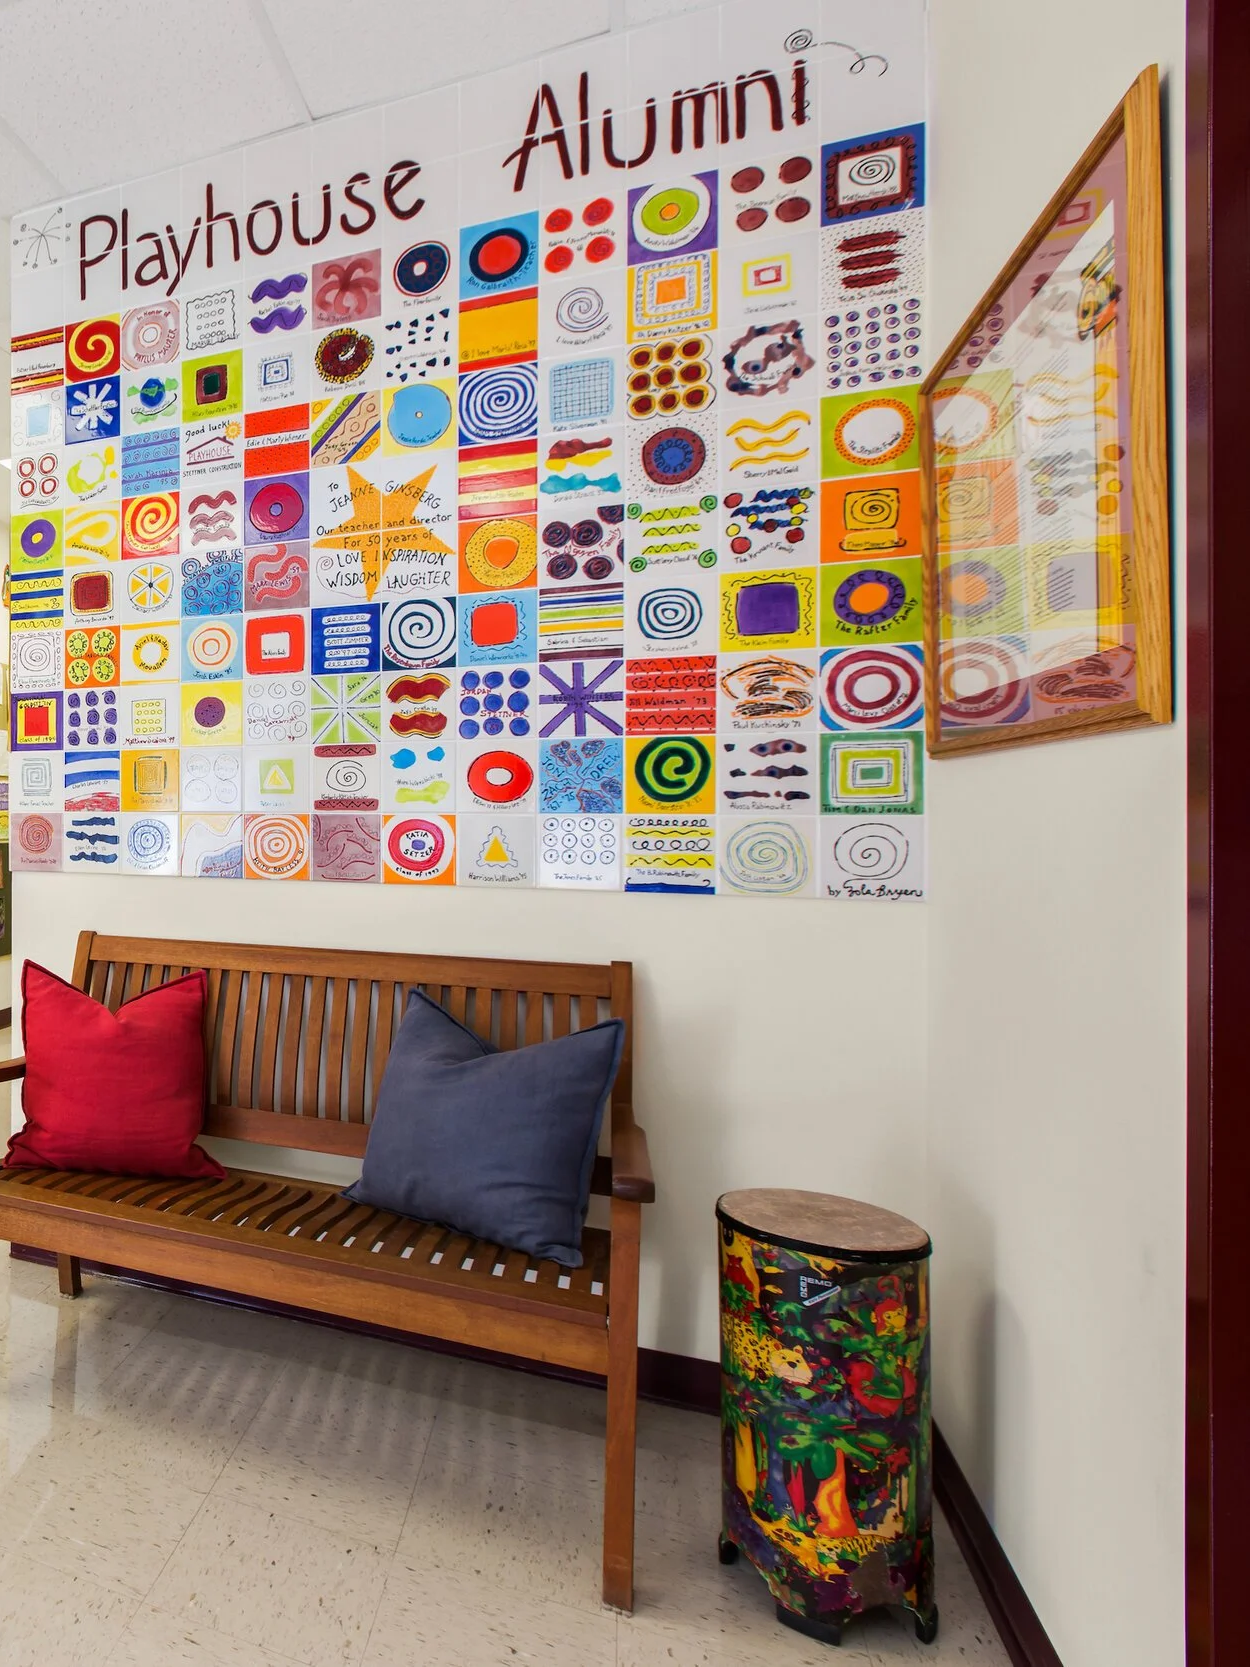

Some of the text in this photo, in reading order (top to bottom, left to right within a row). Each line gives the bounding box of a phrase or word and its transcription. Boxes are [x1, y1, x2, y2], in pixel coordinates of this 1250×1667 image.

[79, 50, 810, 301] Playhouse Alumni
[133, 351, 157, 365] PHYLLIS
[157, 327, 179, 361] MAURER
[188, 445, 232, 462] PLAYHOUSE
[329, 480, 442, 513] JEANNE GINSBERG
[316, 512, 452, 537] Our teacher and director
[343, 528, 434, 550] For 50 years of
[336, 549, 447, 568] LOVE INSPIRATION
[250, 575, 292, 595] MARK LEWIS
[326, 570, 452, 590] WISDOM LAUGHTER
[835, 619, 852, 635] The
[892, 597, 919, 626] Family
[460, 688, 492, 696] JORDAN
[733, 719, 749, 729] Paul
[541, 756, 565, 779] JON
[590, 752, 621, 780] DREW
[542, 778, 572, 802] ZACH
[406, 830, 429, 840] KATIA
[403, 845, 437, 858] SETZER
[468, 872, 493, 882] Harrison
[827, 885, 842, 897] by
[800, 1276, 832, 1287] REMO
